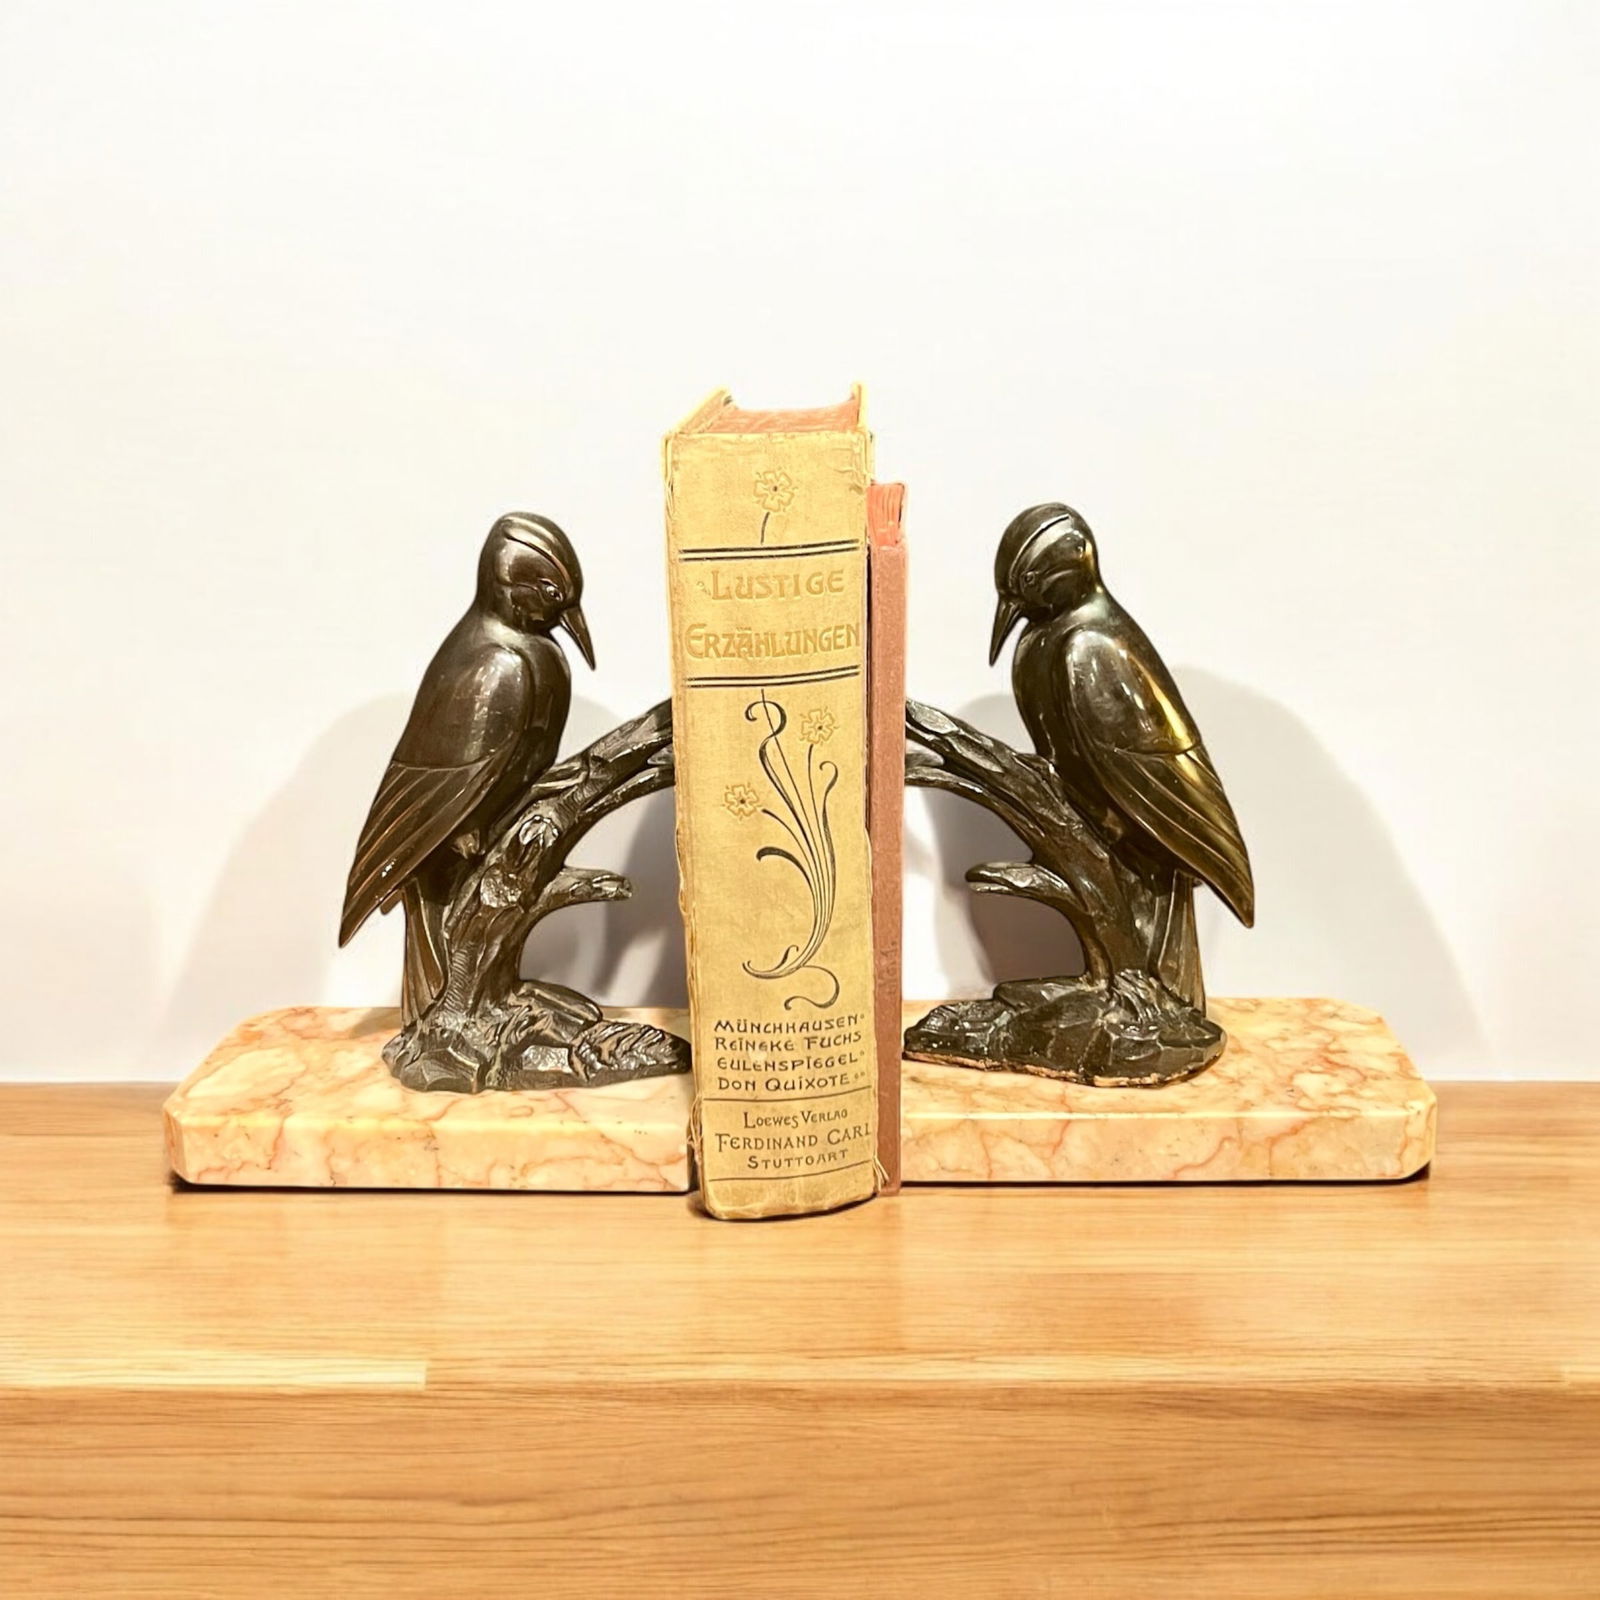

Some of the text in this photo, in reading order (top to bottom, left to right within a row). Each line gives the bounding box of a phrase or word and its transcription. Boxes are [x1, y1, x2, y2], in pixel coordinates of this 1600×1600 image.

[710, 569, 844, 600] LUSTIGE
[685, 622, 861, 659] ERZÄHLUNGEN
[804, 1031, 862, 1050] FUCHS
[718, 1073, 850, 1092] DON QUIXOTE
[743, 1111, 799, 1129] LOEWES
[715, 1123, 872, 1152] FERDINAND CARL
